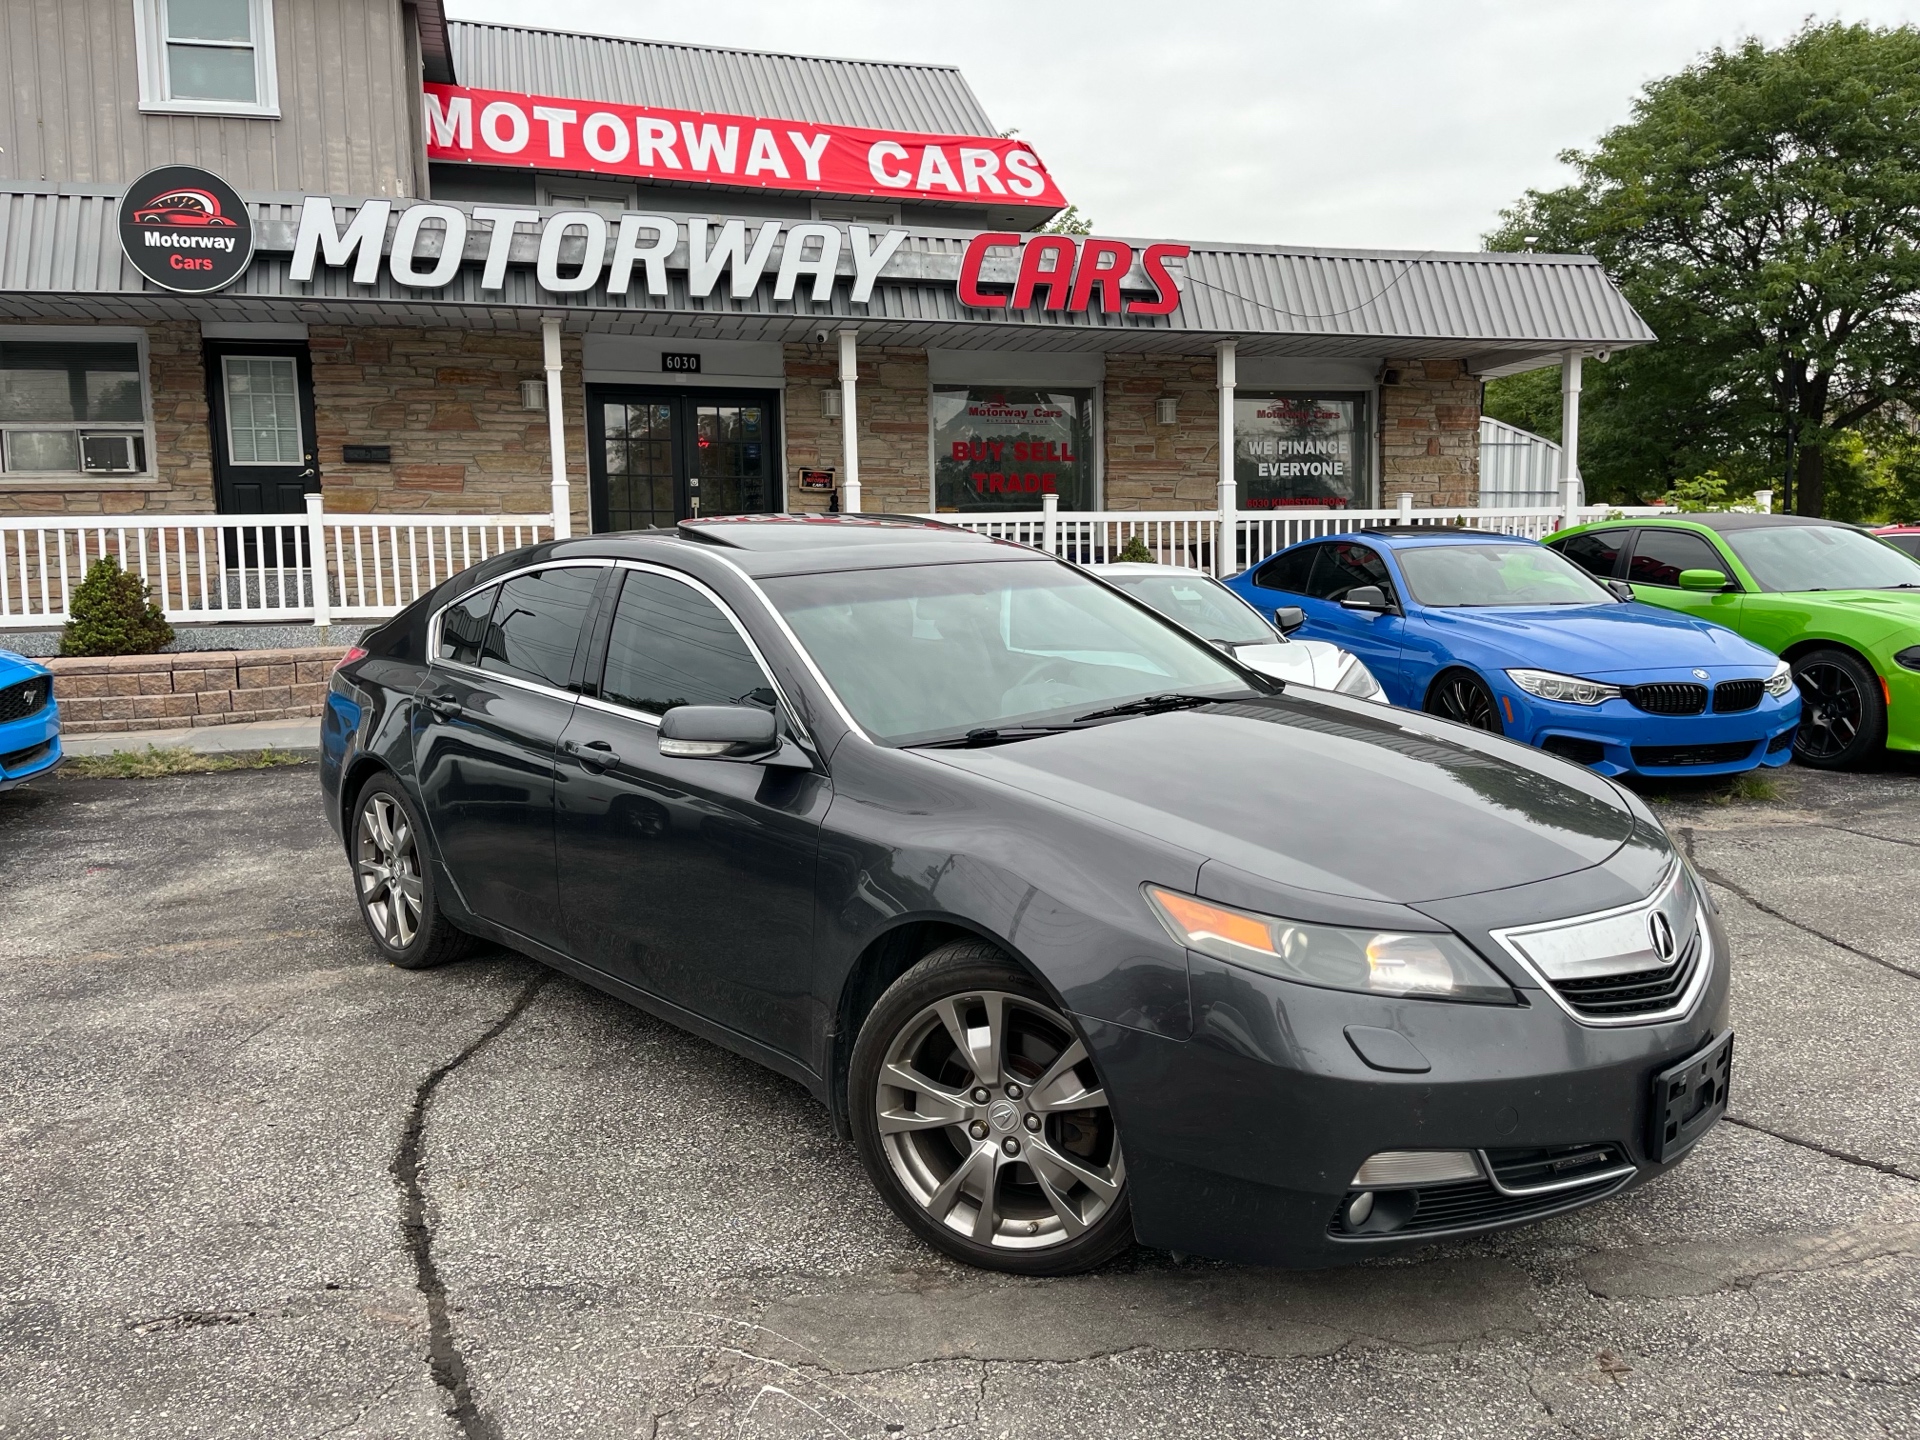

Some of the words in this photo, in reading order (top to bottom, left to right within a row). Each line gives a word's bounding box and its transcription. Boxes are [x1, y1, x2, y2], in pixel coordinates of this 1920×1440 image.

[424, 92, 831, 181] MOTORWAY
[868, 140, 1045, 197] CARS
[144, 231, 235, 253] Motorway
[169, 254, 213, 271] Cars
[288, 196, 910, 304] MOTORWAY
[957, 232, 1191, 315] CARS
[666, 356, 697, 370] 6030
[968, 407, 1028, 419] Motorway
[1034, 408, 1062, 418] Cars
[1256, 410, 1310, 419] Motorway
[1313, 409, 1340, 419] Cars
[952, 441, 1005, 462] BUY
[1014, 441, 1076, 462] SELL
[1248, 441, 1273, 455] WE
[1278, 441, 1348, 455] FINANCE
[1258, 462, 1344, 477] EVERYONE
[971, 472, 1057, 494] TRADE
[1246, 498, 1269, 508] 6030
[1272, 497, 1320, 507] KINGSTON
[1322, 497, 1347, 506] ROAD
